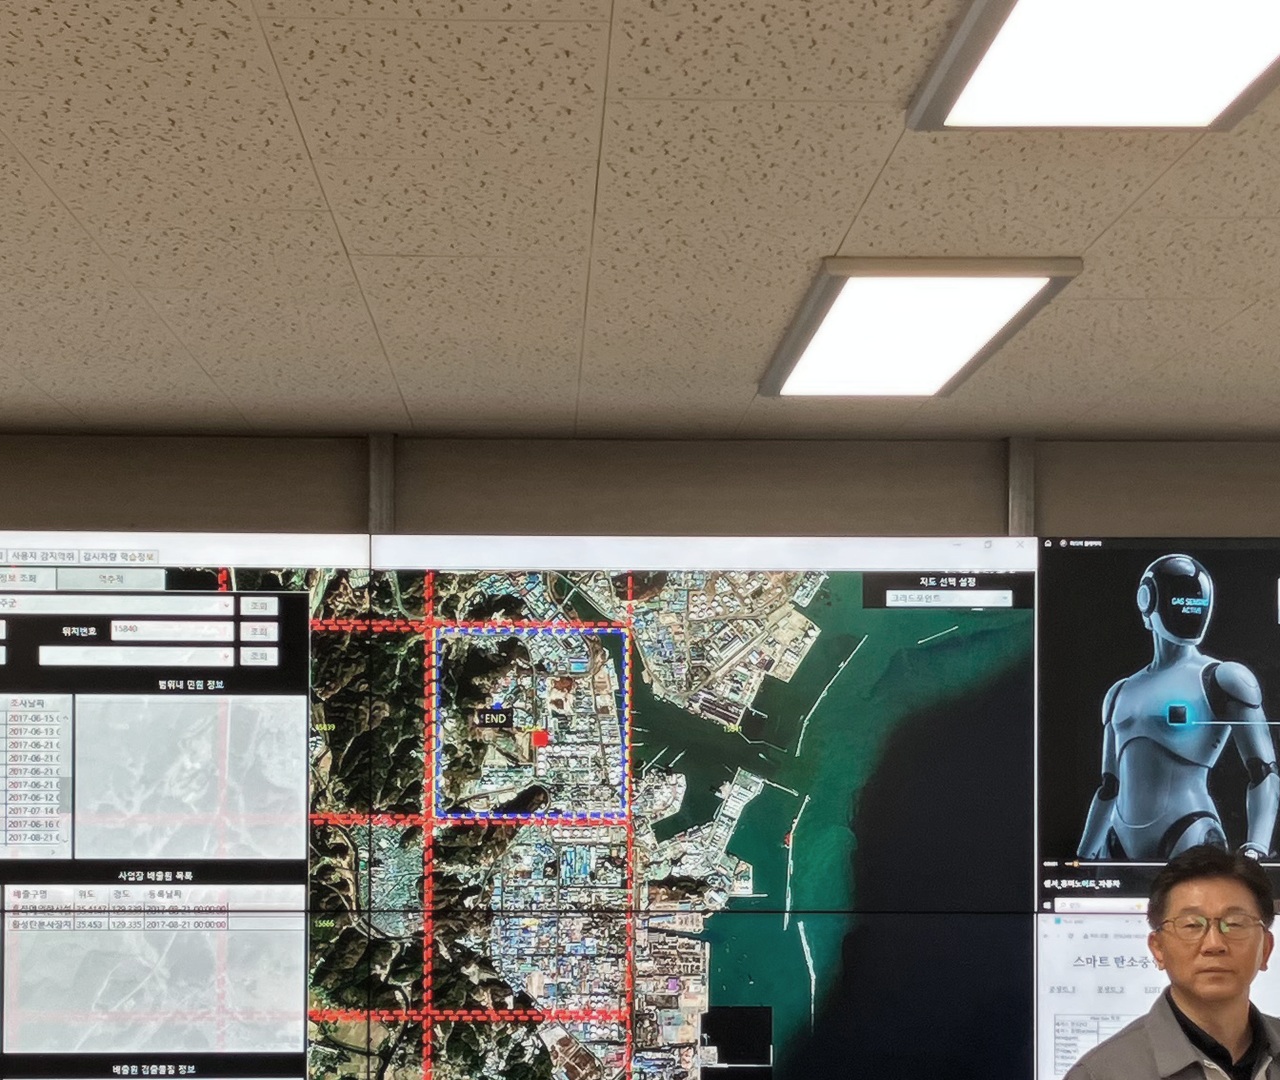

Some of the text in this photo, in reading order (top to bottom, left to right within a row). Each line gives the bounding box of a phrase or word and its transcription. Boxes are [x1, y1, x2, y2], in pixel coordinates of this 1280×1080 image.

[0, 573, 17, 583] 정보
[20, 574, 37, 584] 조회
[919, 577, 937, 587] 지도
[958, 577, 977, 587] 설정
[250, 601, 268, 611] 조회
[158, 679, 184, 690] 범위내
[207, 679, 225, 690] 정보
[485, 713, 507, 724] END
[118, 870, 145, 881] 사업장
[175, 871, 193, 881] 목록
[78, 889, 95, 899] 위도
[1073, 955, 1158, 969] 스마트 탄소중
[178, 1064, 196, 1074] 정보
